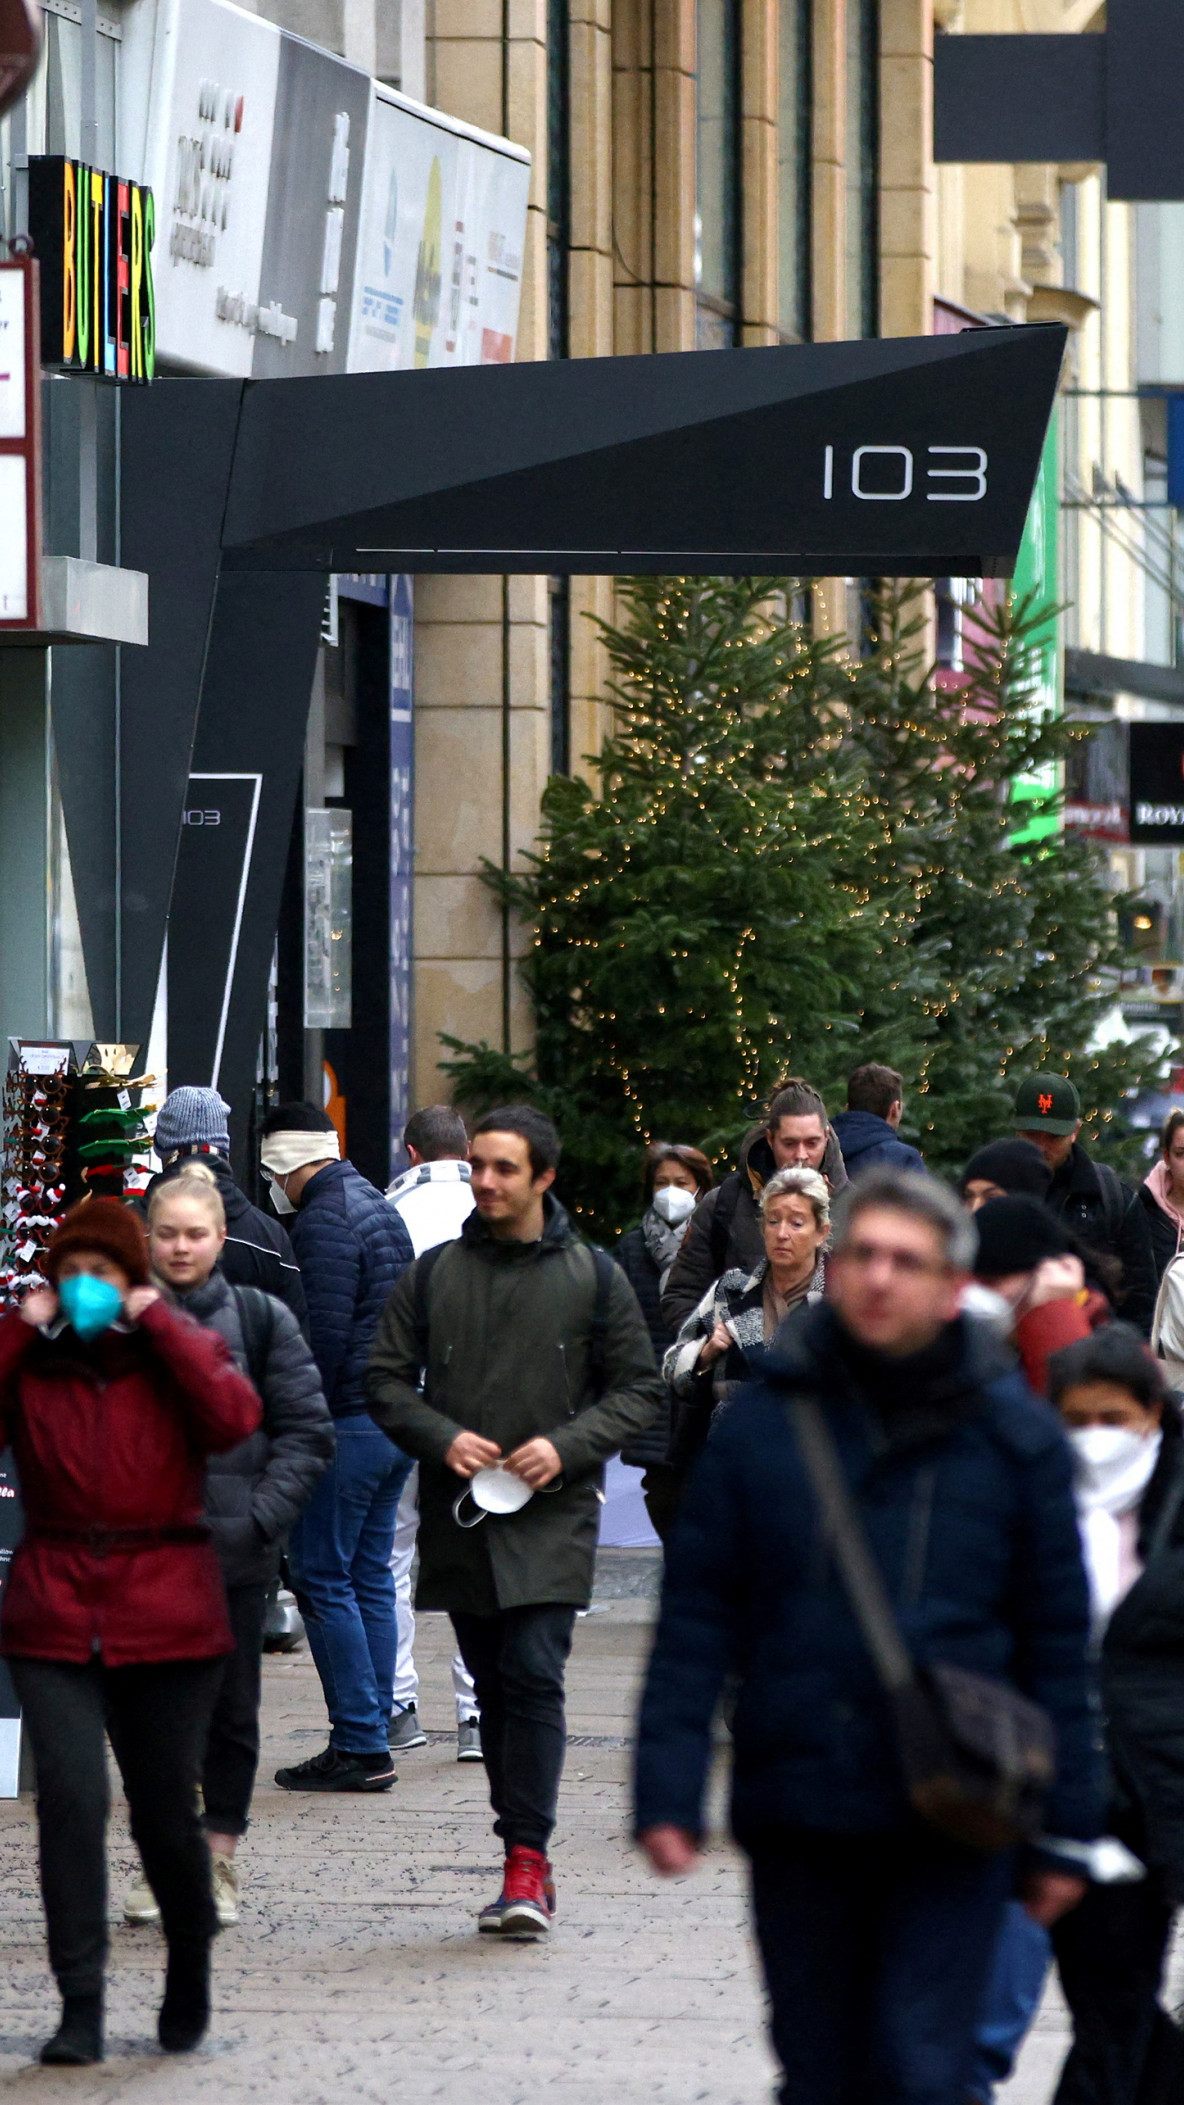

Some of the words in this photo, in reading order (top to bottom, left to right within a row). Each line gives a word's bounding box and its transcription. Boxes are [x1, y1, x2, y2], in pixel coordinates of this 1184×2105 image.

[63, 159, 155, 386] BUTLERS
[824, 445, 988, 501] 103
[1136, 801, 1184, 825] ROY
